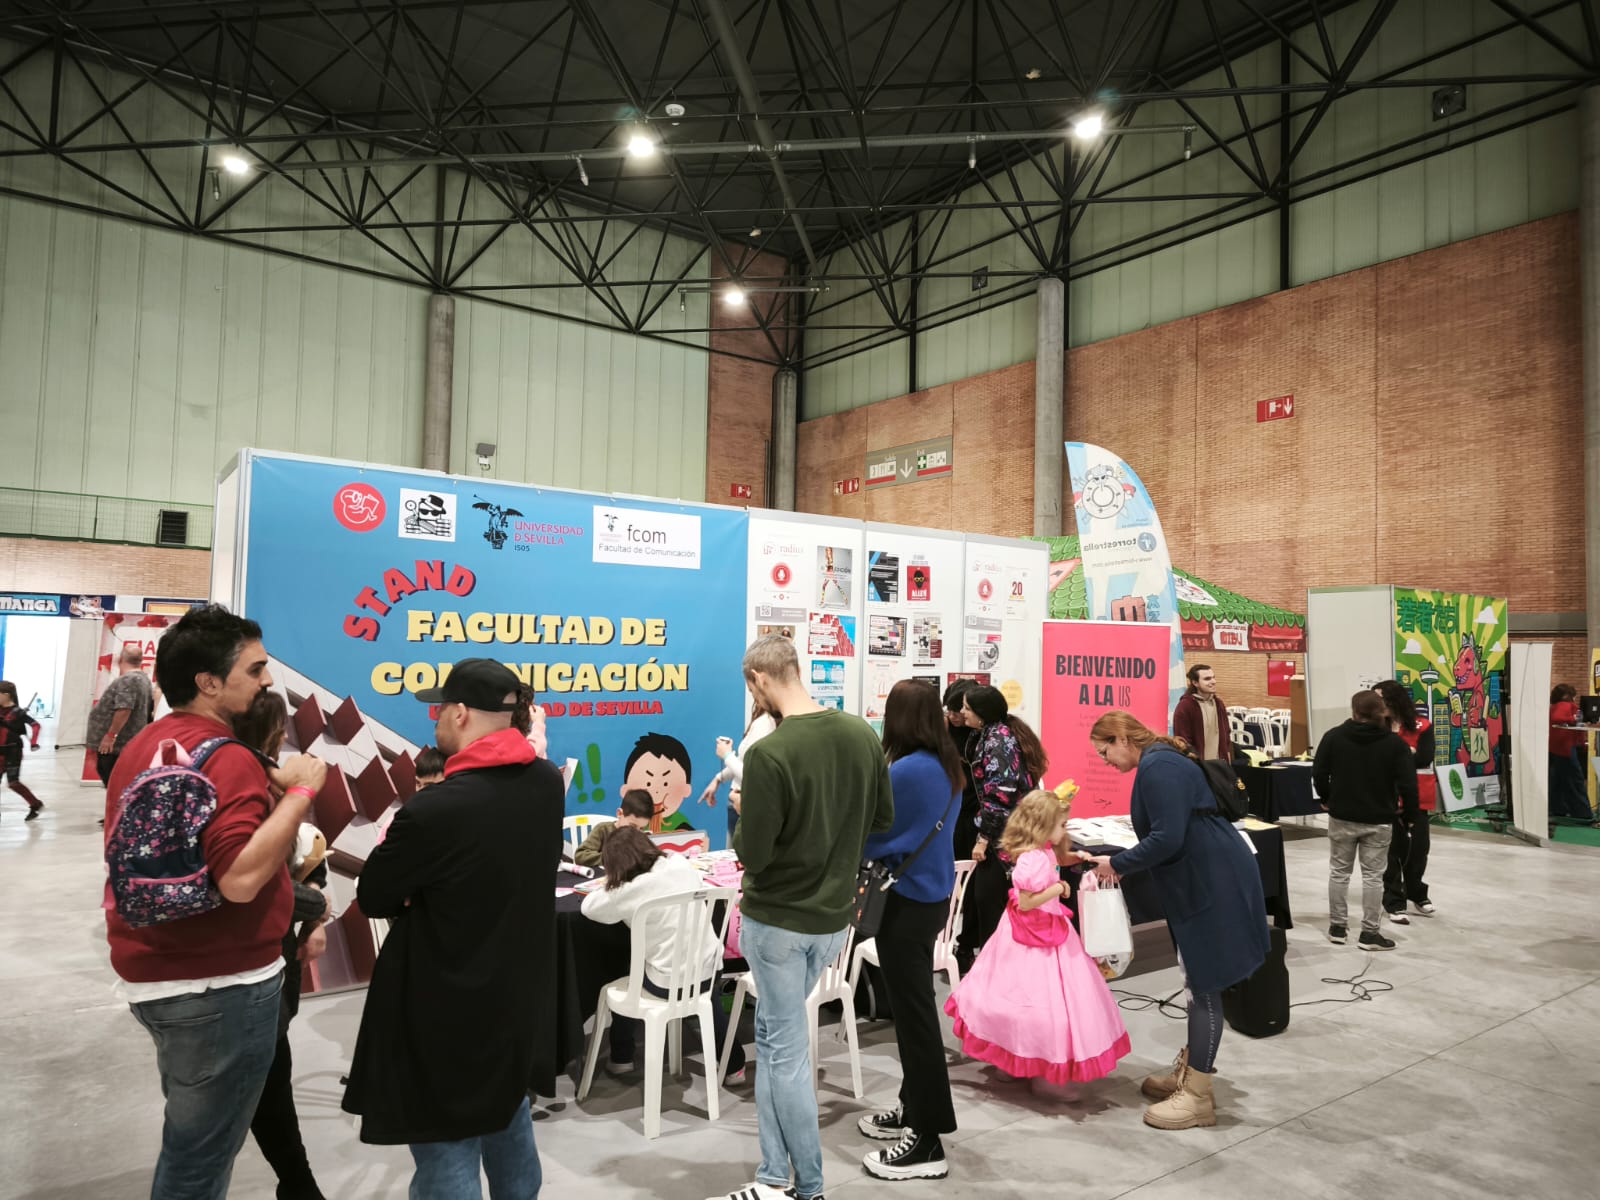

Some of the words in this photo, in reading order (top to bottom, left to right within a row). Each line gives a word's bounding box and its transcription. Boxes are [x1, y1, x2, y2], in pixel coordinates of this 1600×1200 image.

[514, 521, 584, 536] UNIVERSIDAD
[627, 524, 667, 545] fcom
[525, 534, 565, 546] SEVILLA
[598, 543, 632, 554] Facultad
[633, 546, 644, 555] de
[644, 547, 697, 559] Comunicación
[1011, 581, 1023, 596] 20
[343, 560, 477, 642] STAND
[407, 610, 615, 644] FACULTAD
[620, 617, 668, 646] DE
[1055, 654, 1156, 679] BIENVENIDO
[1078, 684, 1090, 705] A
[1094, 685, 1114, 706] LA
[1118, 686, 1131, 707] US
[569, 701, 593, 716] DE
[595, 700, 663, 716] SEVILLA
